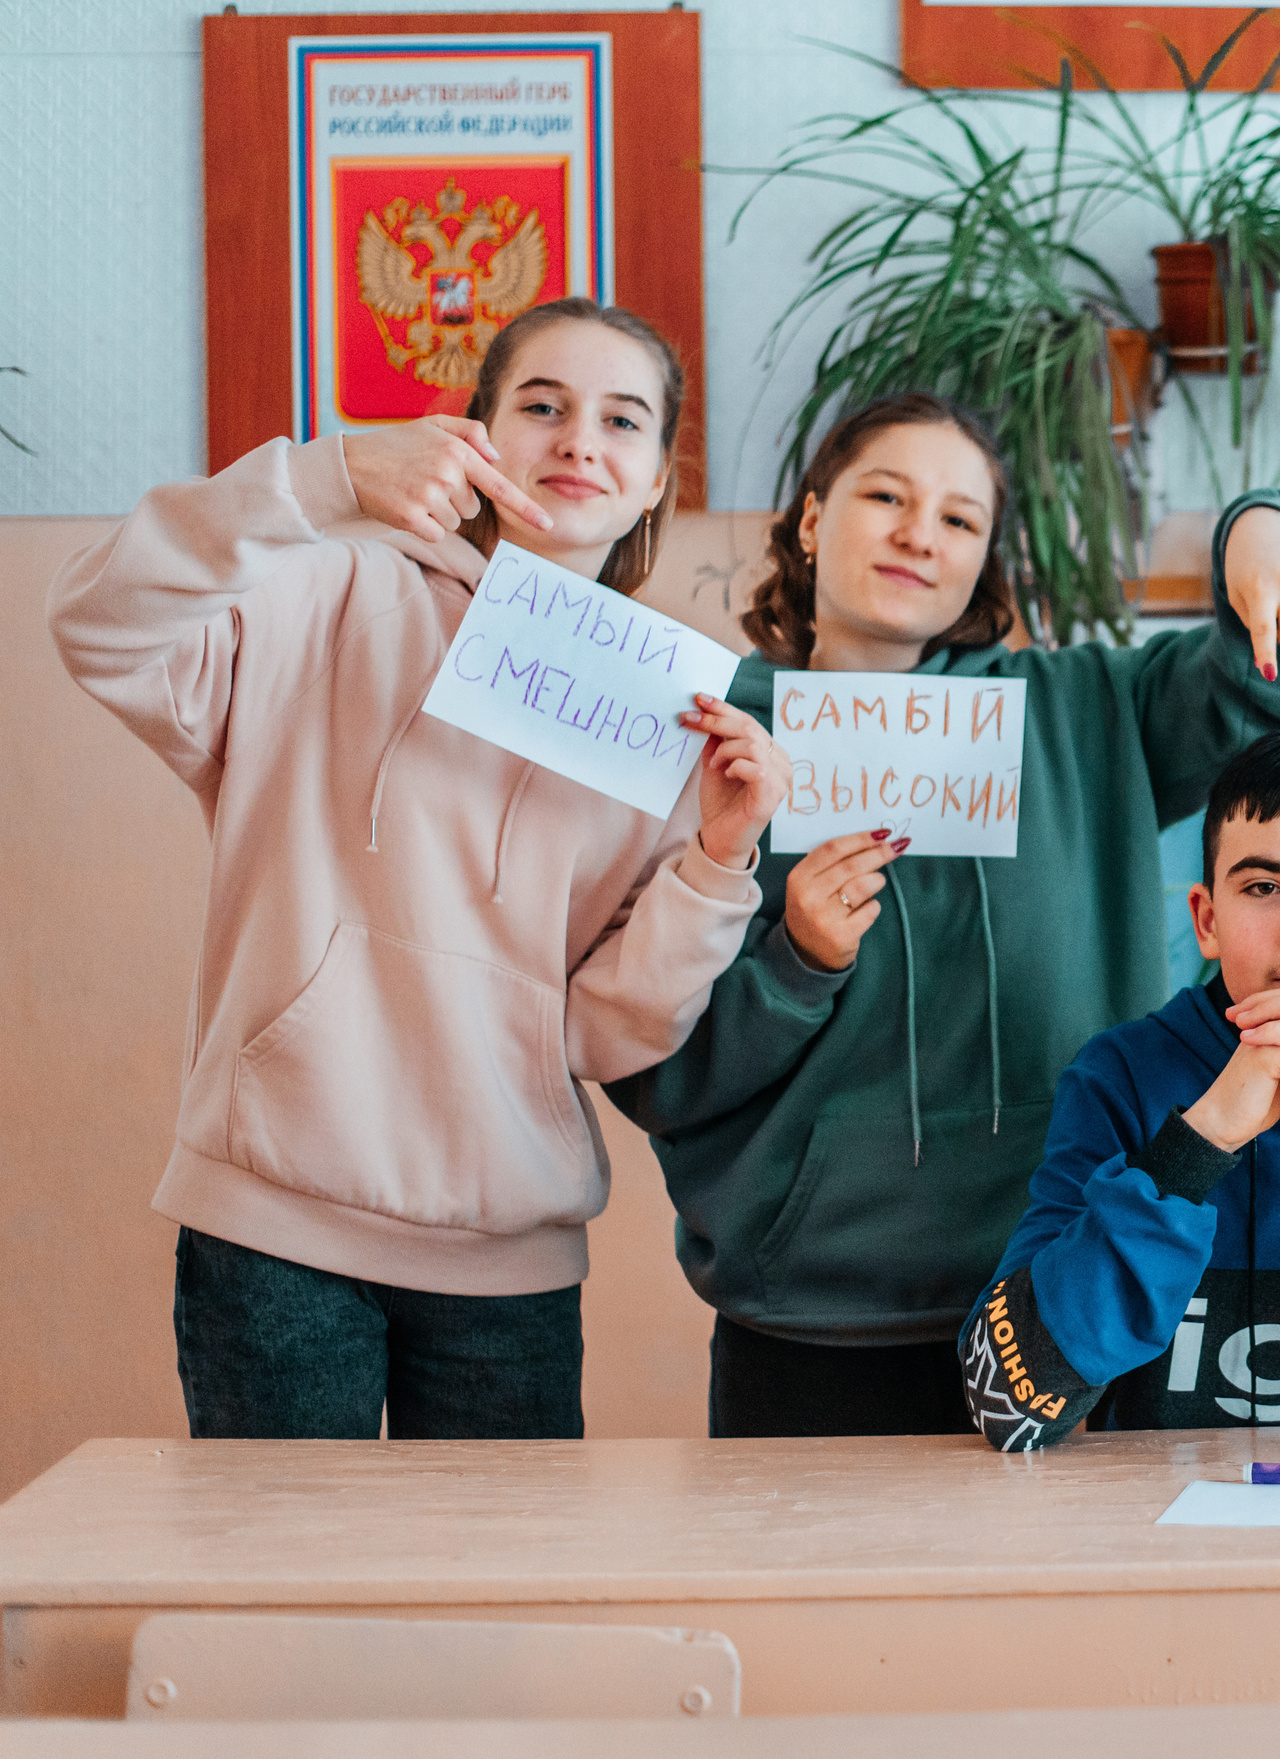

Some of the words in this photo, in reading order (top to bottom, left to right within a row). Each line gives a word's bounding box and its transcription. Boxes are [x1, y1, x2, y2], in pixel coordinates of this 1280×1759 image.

[328, 109, 454, 138] РОССИЙСКОЙ
[484, 556, 682, 673] САМЫЙ
[786, 759, 1020, 829] ВЫСОКИЙ
